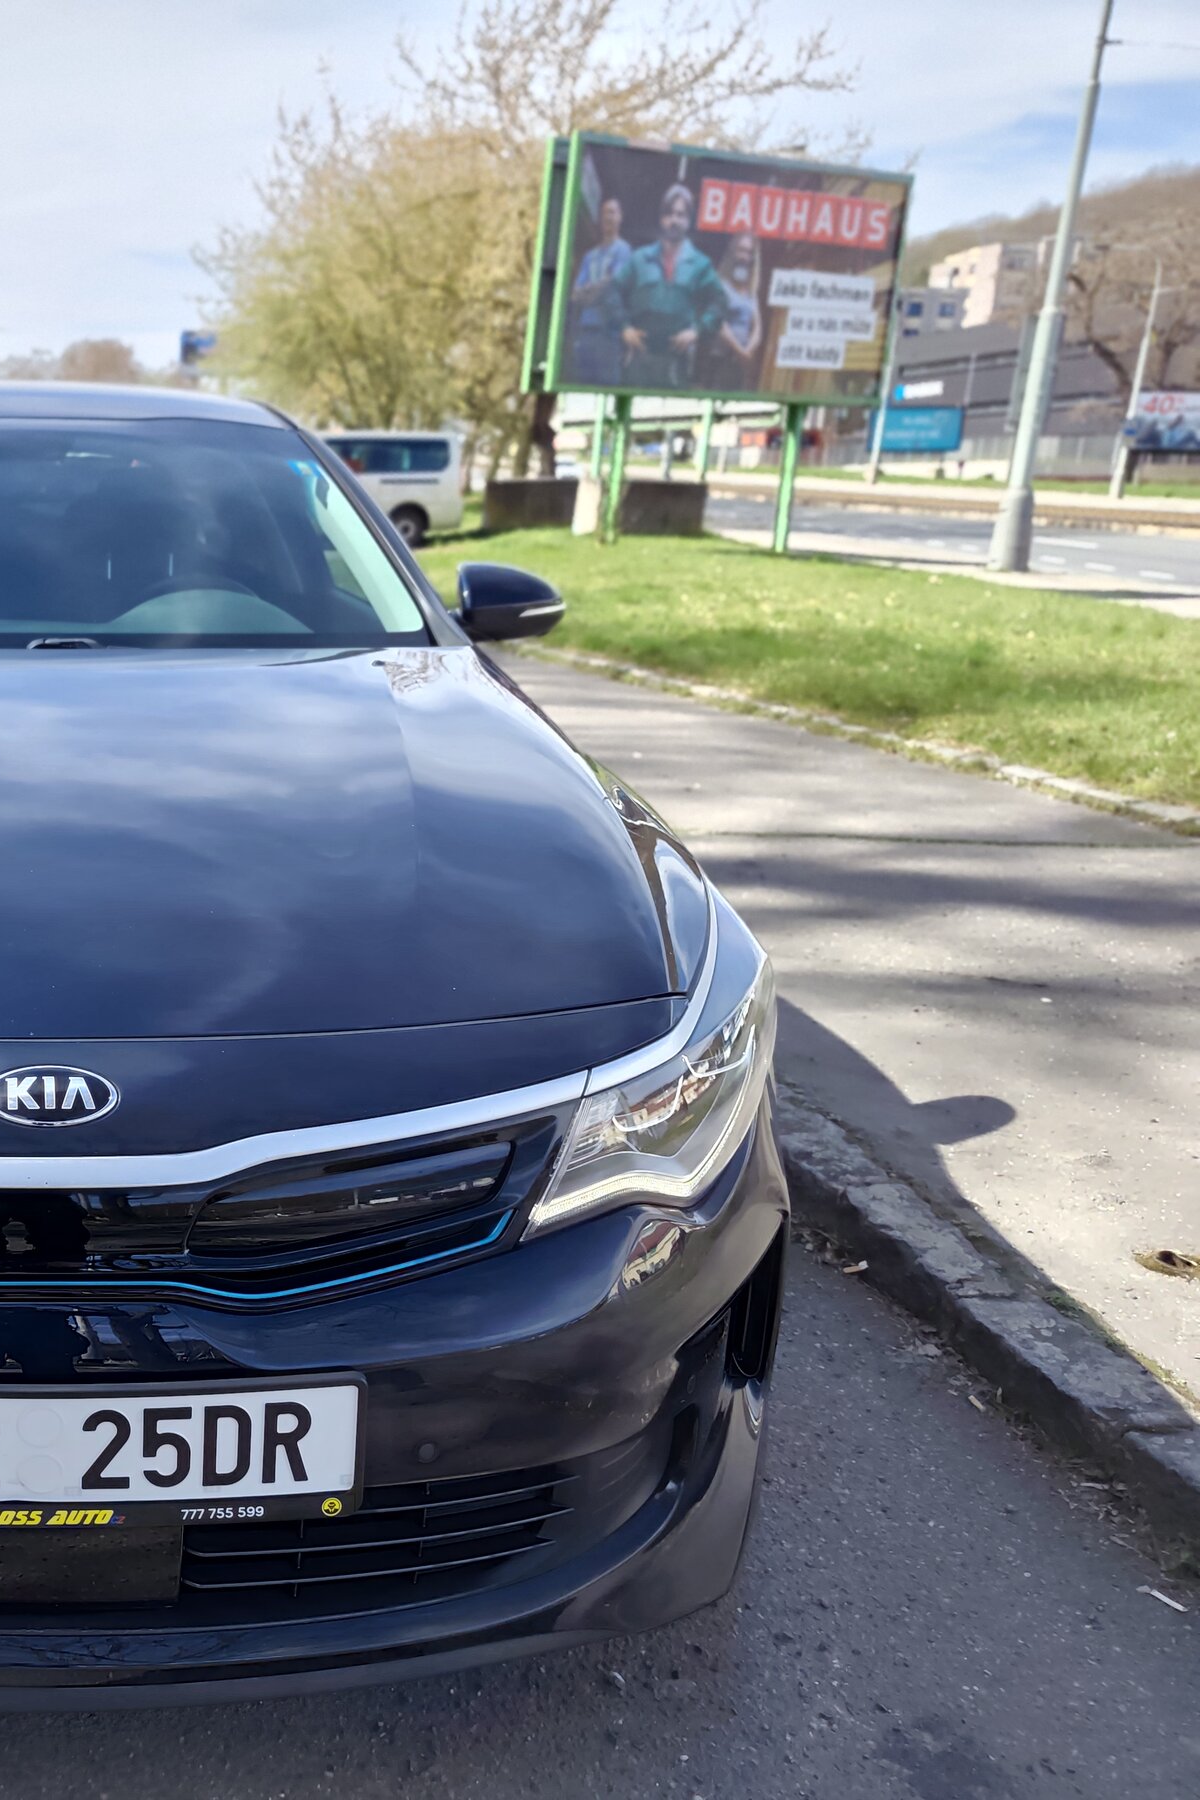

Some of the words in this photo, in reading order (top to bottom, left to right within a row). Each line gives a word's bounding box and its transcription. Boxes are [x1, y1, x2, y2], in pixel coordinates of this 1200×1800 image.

[703, 188, 887, 243] BAUHAUS
[5, 1076, 96, 1110] KIA
[81, 1401, 312, 1490] 25DR
[45, 1509, 114, 1526] AUTO
[181, 1508, 205, 1520] 777
[208, 1507, 234, 1520] 755
[237, 1505, 265, 1518] 599
